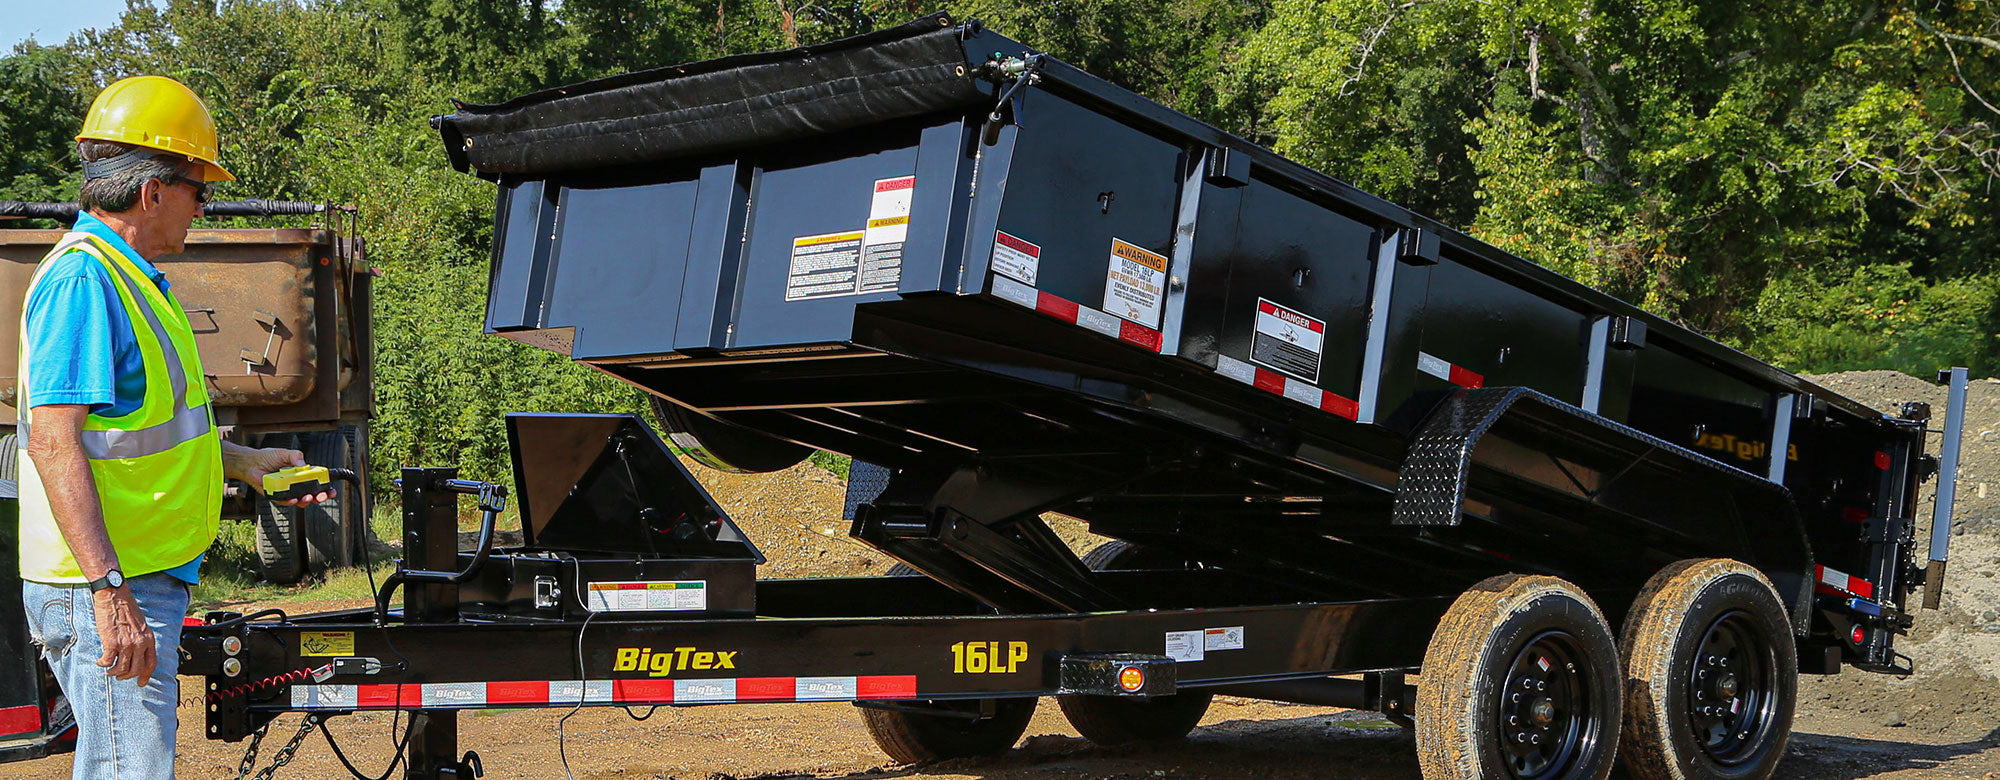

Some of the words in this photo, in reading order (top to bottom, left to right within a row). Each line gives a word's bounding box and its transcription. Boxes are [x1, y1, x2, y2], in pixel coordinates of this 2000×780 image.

[885, 179, 911, 189] DANGER
[880, 217, 904, 225] WARNING
[1008, 237, 1034, 253] DANGER
[1124, 246, 1162, 269] WARNING
[1121, 258, 1140, 273] MODEL
[1111, 270, 1119, 280] NET
[1120, 272, 1139, 288] PAYLOAD
[1114, 281, 1129, 291] EVENLY
[1130, 287, 1155, 301] DISTRIBUTED
[1086, 313, 1112, 329] BigTex
[1281, 310, 1310, 329] DANGER
[613, 646, 738, 678] BigTex
[951, 641, 1028, 674] 16LP
[500, 687, 536, 698] BigTex
[624, 685, 661, 697] BigTex
[687, 684, 724, 695] BigTex
[749, 683, 783, 693] BigTex
[808, 682, 844, 692] BigTex
[869, 681, 903, 691] BigTex
[435, 688, 473, 700] BigTex
